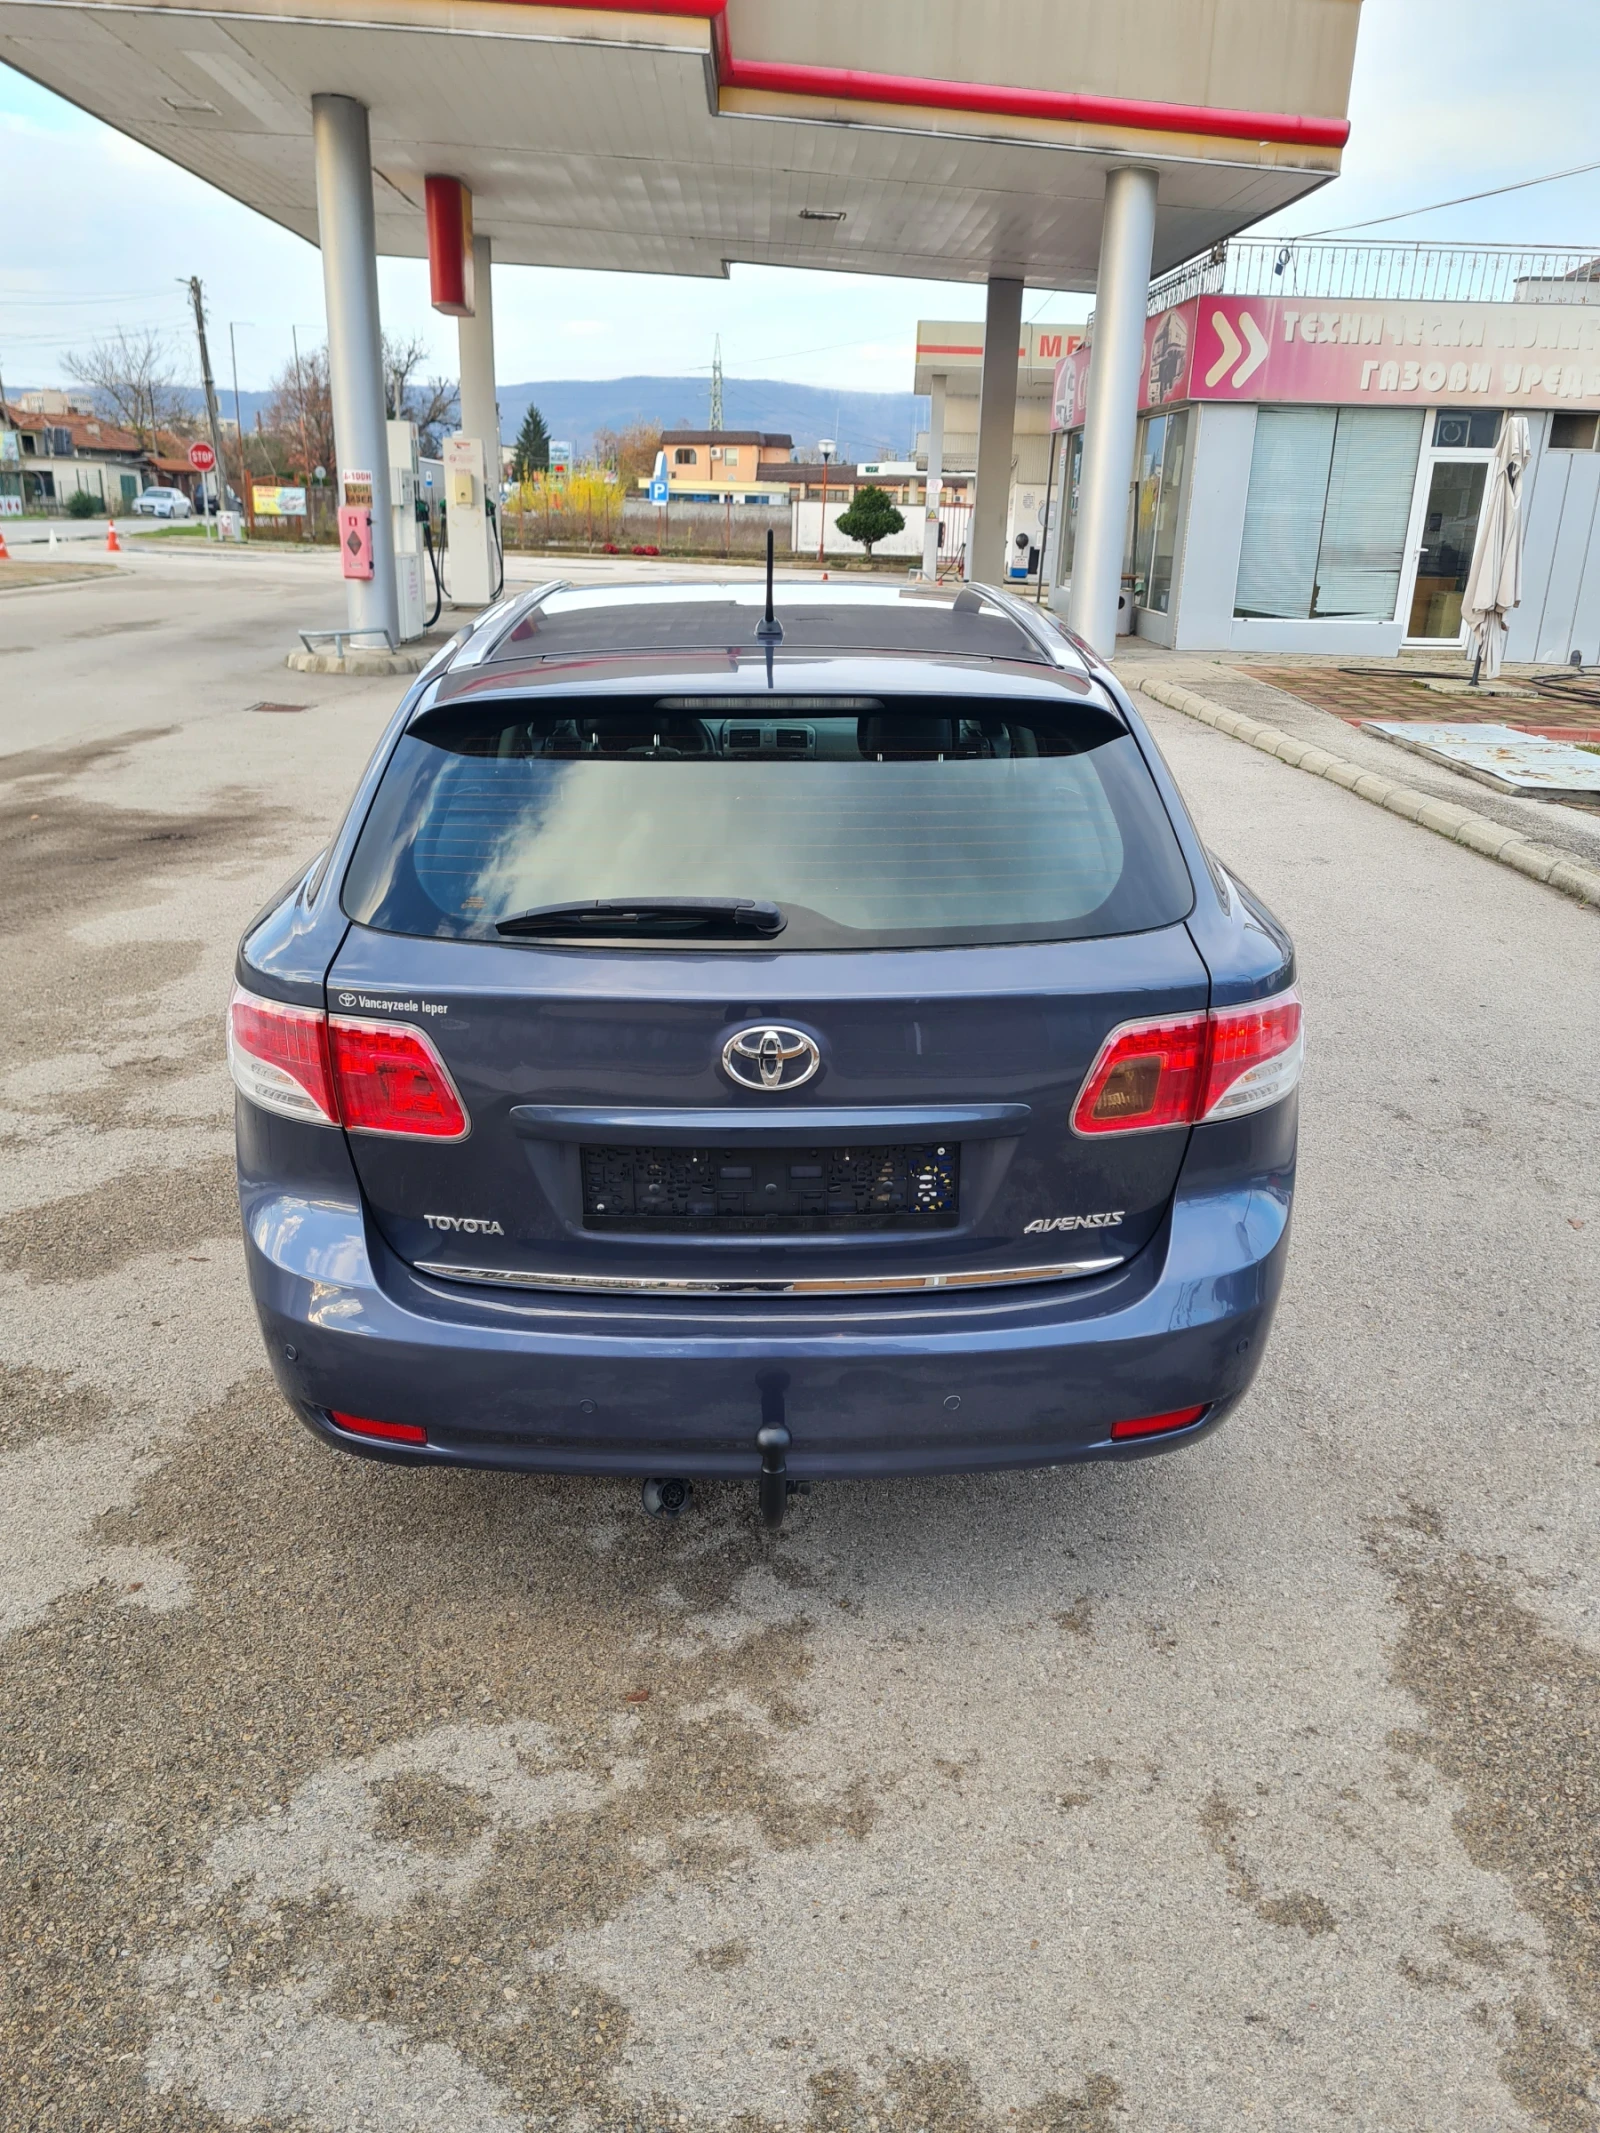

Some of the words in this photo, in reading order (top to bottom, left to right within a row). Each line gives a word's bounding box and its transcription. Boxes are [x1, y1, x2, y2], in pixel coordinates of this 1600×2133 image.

[1284, 312, 1484, 347] ТЕХНИЧЕСКИ
[1360, 360, 1491, 395] ГАЗОВИ
[191, 450, 213, 463] STOP
[654, 483, 665, 499] P
[358, 995, 419, 1012] Vancayzeele
[421, 1001, 449, 1016] Ieper
[423, 1214, 505, 1236] TOYOTA
[1023, 1210, 1126, 1234] AVENSIS
